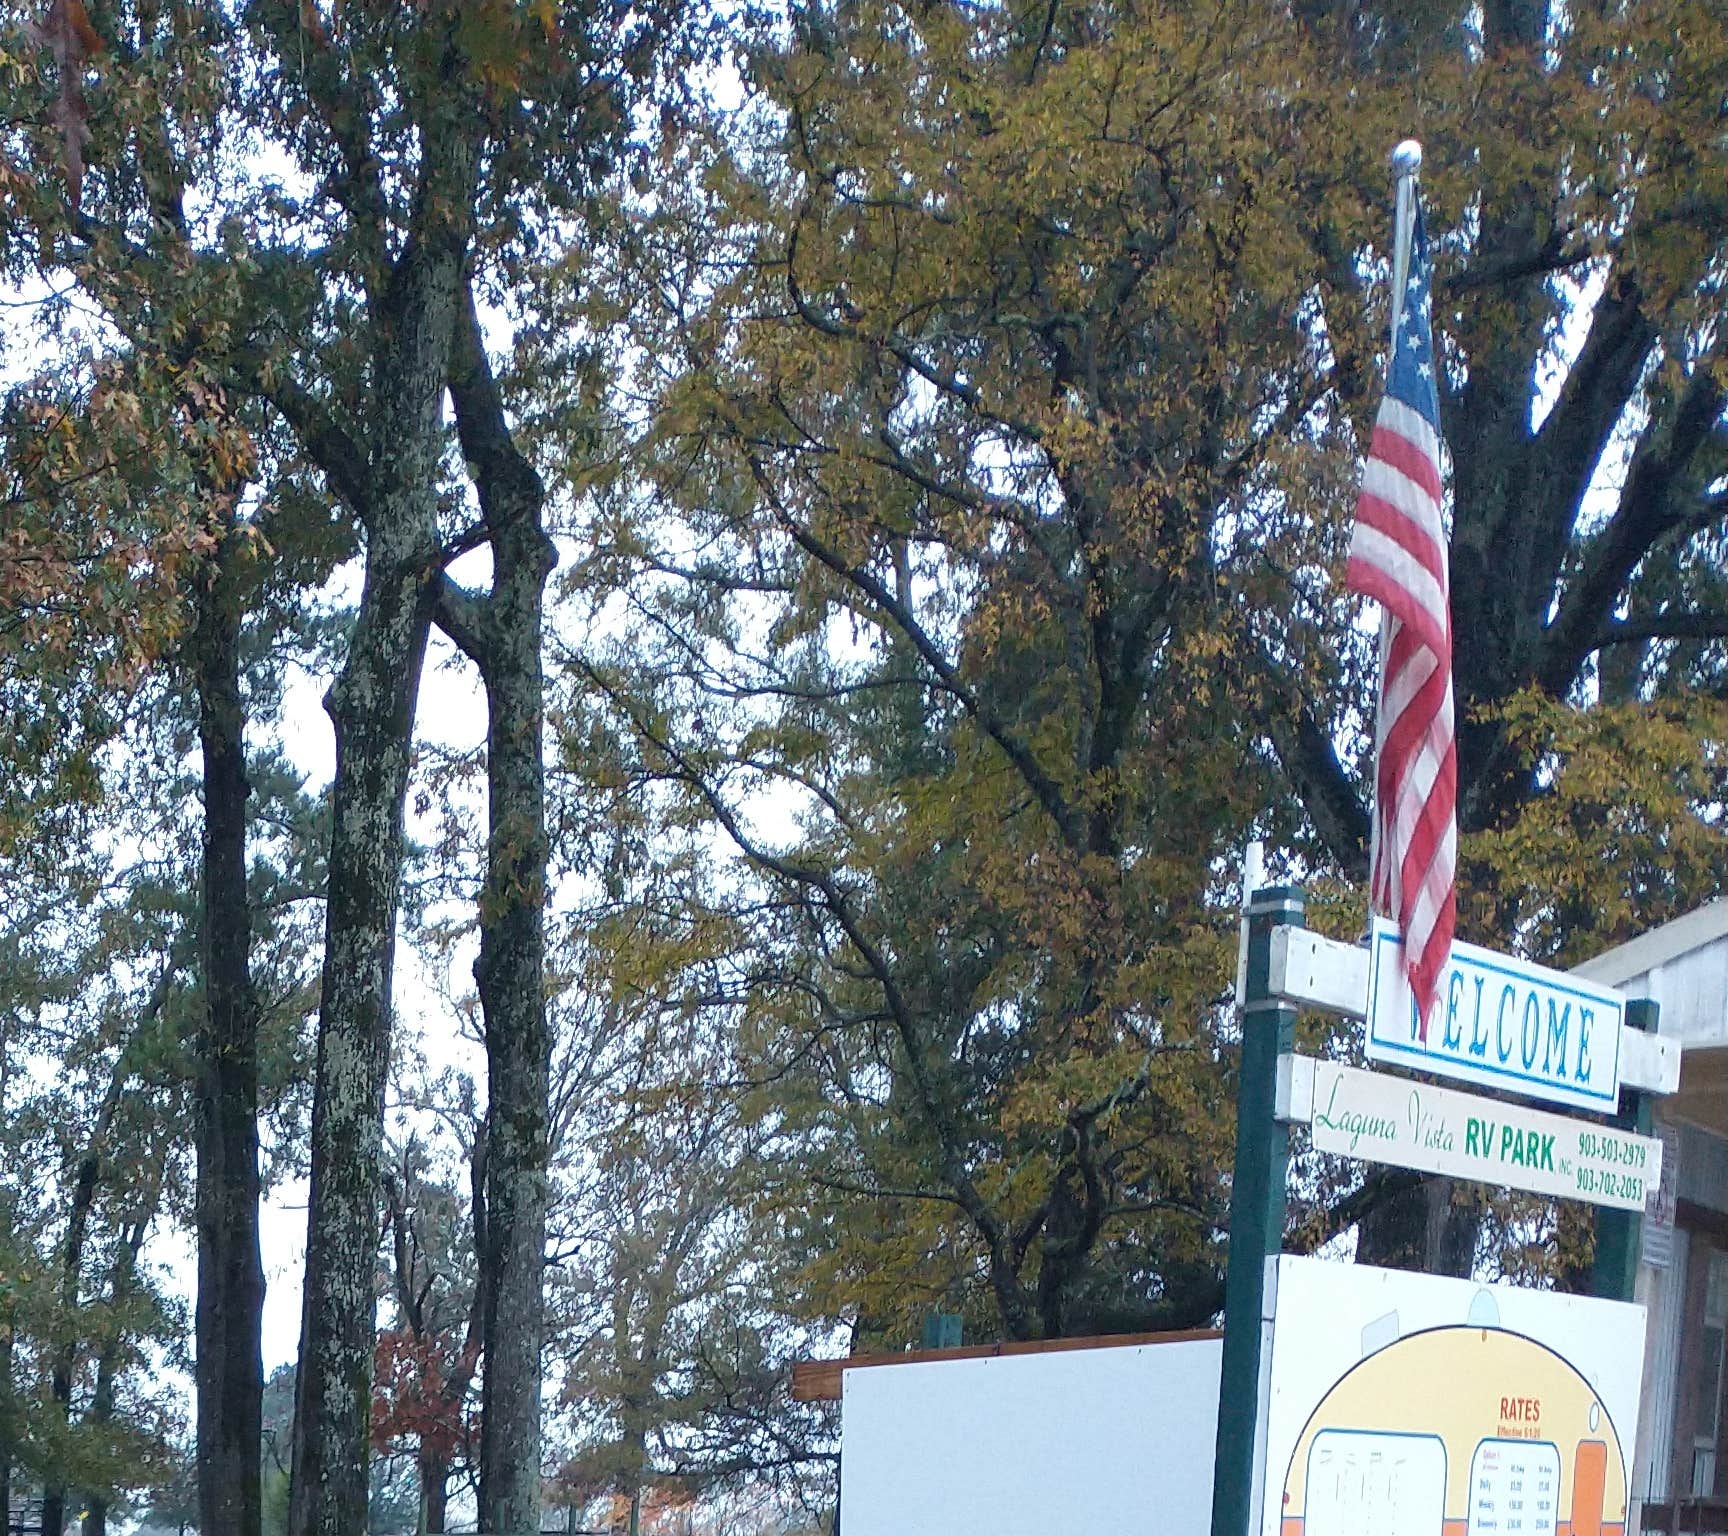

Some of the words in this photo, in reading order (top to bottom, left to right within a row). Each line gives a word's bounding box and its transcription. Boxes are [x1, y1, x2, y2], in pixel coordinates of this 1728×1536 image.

[1315, 1073, 1397, 1152] Laguna
[1408, 1089, 1455, 1152] Vista
[1465, 1117, 1495, 1158] RV
[1500, 1124, 1556, 1173] PARK
[1500, 1397, 1541, 1422] RATES
